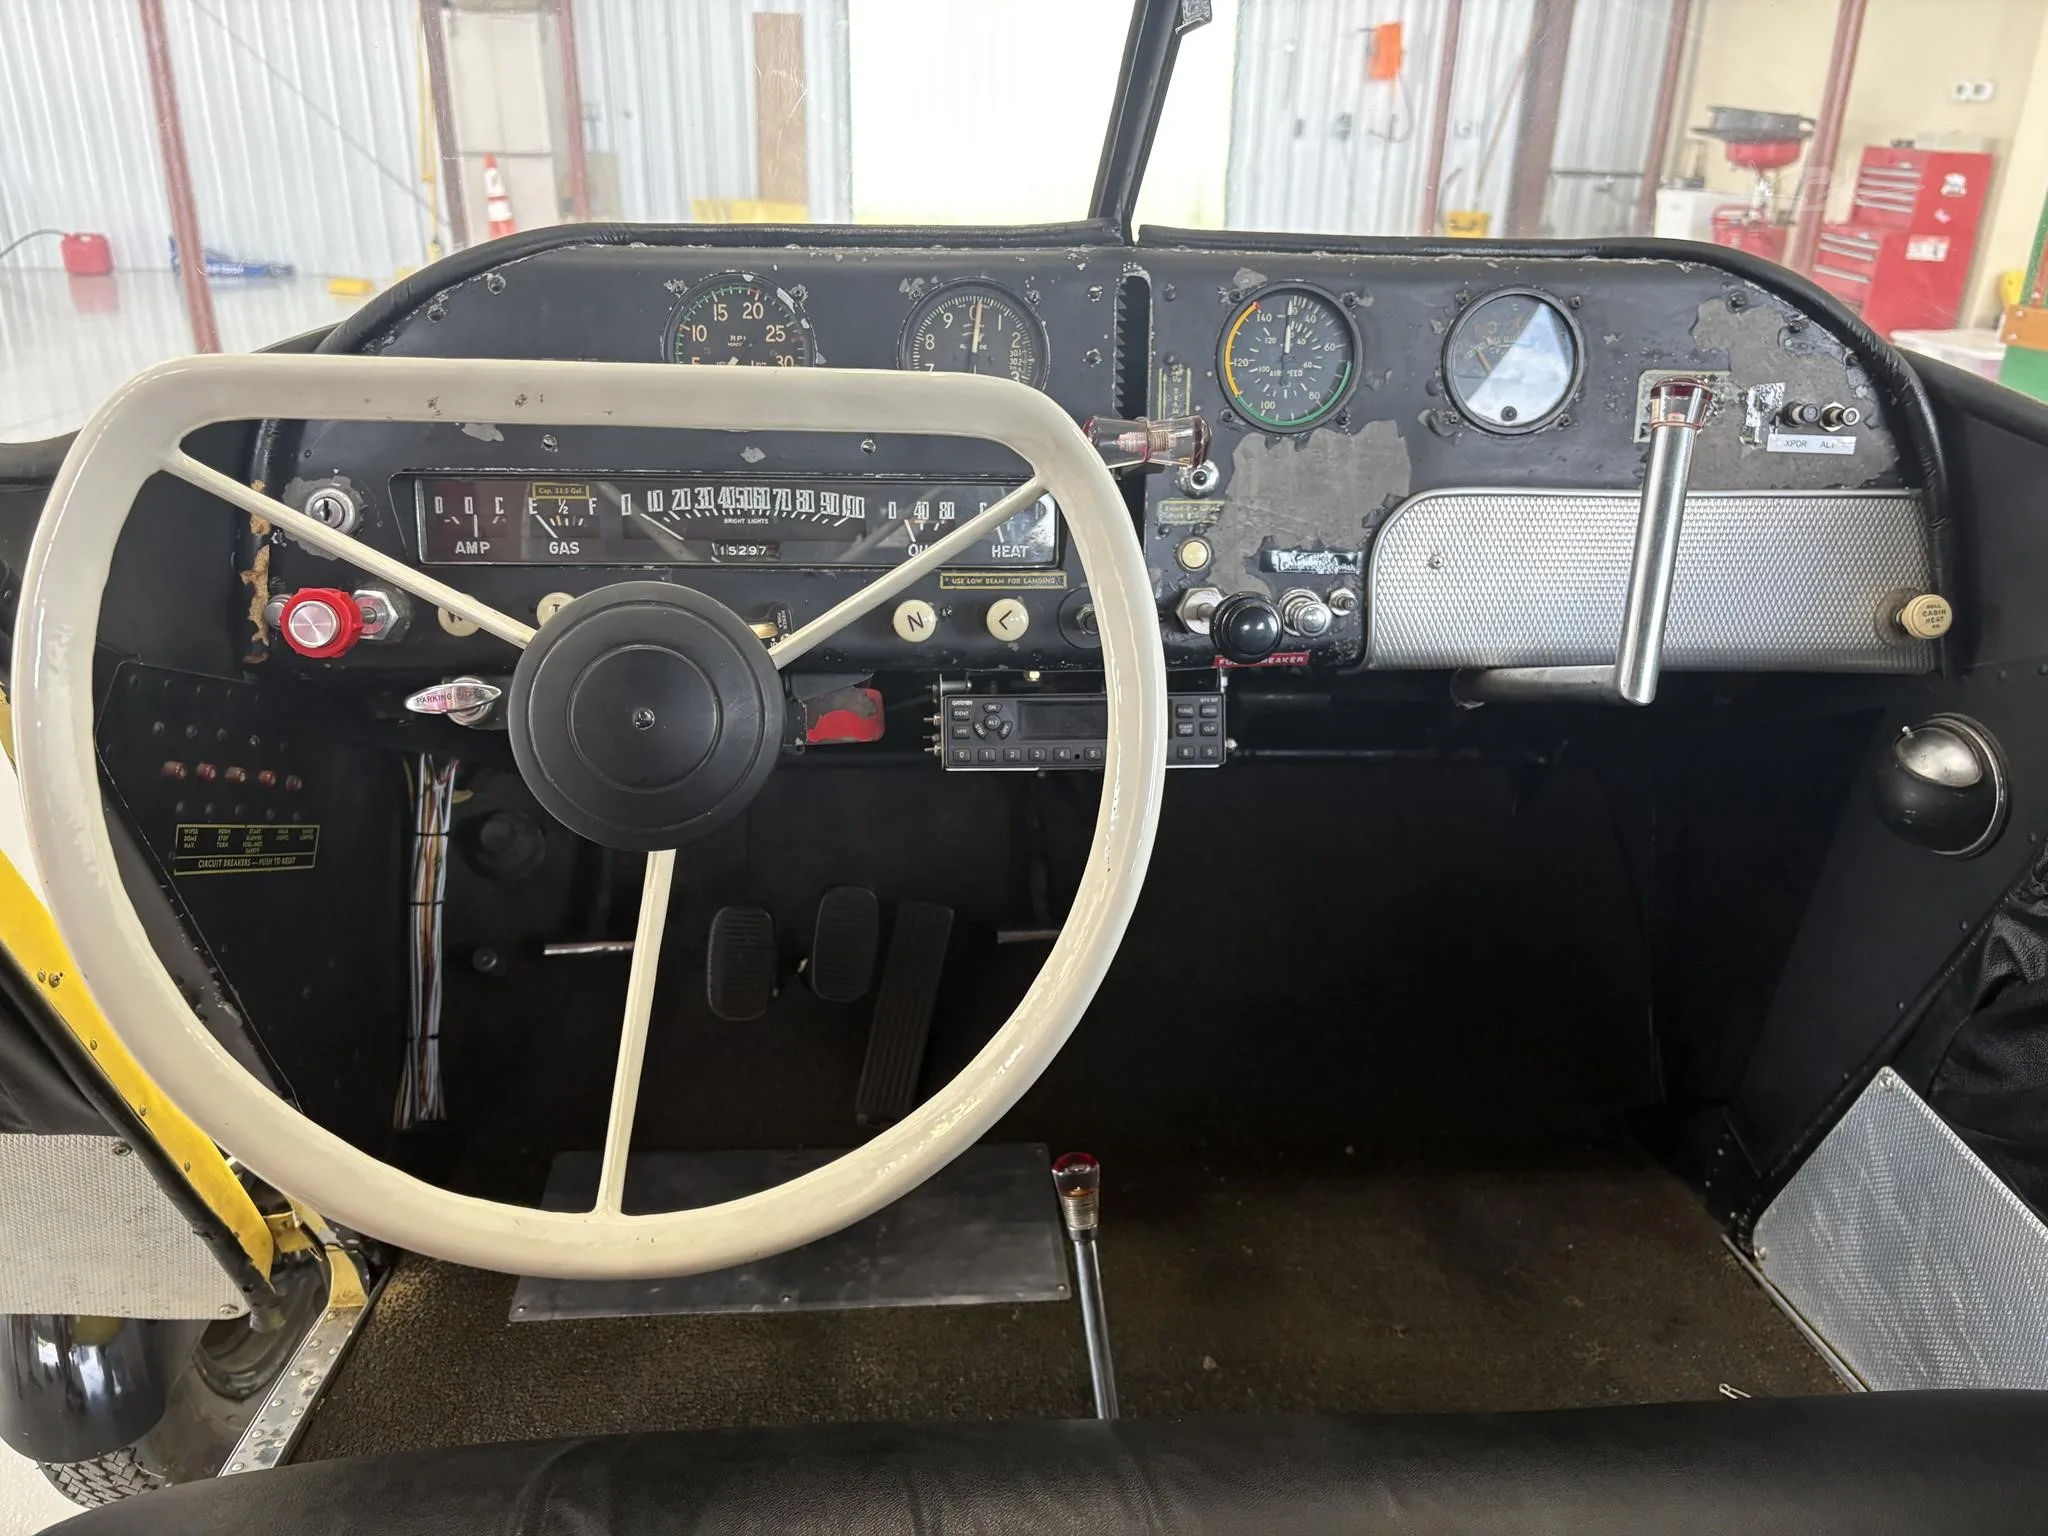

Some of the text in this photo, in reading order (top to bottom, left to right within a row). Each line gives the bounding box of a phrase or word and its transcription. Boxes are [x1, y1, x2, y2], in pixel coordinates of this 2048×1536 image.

[713, 303, 728, 321] 15
[742, 302, 764, 320] 20
[943, 312, 953, 329] 9
[1256, 313, 1273, 322] 140
[1304, 314, 1317, 323] 40
[692, 324, 708, 342] 10
[765, 324, 786, 342] 25
[925, 333, 935, 350] 8
[1011, 331, 1021, 348] 2
[1264, 336, 1277, 344] 120
[1324, 342, 1336, 352] 60
[1233, 358, 1249, 367] 120
[1303, 361, 1313, 369] 60
[1258, 365, 1270, 373] 100
[1269, 369, 1282, 377] AIR
[1308, 391, 1321, 400] 80
[1260, 401, 1276, 410] 100
[1784, 438, 1808, 449] XPDR
[495, 496, 505, 515] C
[528, 497, 538, 515] E
[588, 497, 598, 516] F
[647, 489, 664, 513] 10
[671, 487, 691, 511] 20
[694, 486, 715, 509] 30
[717, 486, 735, 509] 40
[735, 486, 753, 511] 50
[753, 486, 771, 510] 60
[772, 488, 792, 512] 70
[795, 489, 815, 513] 80
[820, 491, 840, 516] 90
[841, 494, 865, 519] 100
[913, 501, 930, 520] 40
[938, 501, 955, 520] 80
[455, 541, 490, 554] AMP
[549, 541, 580, 554] GAS
[719, 545, 767, 556] 15297
[991, 544, 1029, 558] HEAT
[985, 577, 1005, 585] BEAM
[1007, 577, 1021, 585] FOR
[1023, 577, 1056, 585] LANDING
[1922, 609, 1946, 617] CABIN
[907, 611, 924, 632] N
[415, 693, 453, 703] PARKING
[959, 751, 965, 759] 0
[985, 751, 989, 759] 1
[1010, 751, 1016, 759] 2
[1034, 750, 1040, 758] 3
[1059, 750, 1065, 758] 4
[1090, 750, 1096, 758] 5
[198, 859, 222, 868] CIRCUIT
[223, 858, 251, 867] BREAKERS
